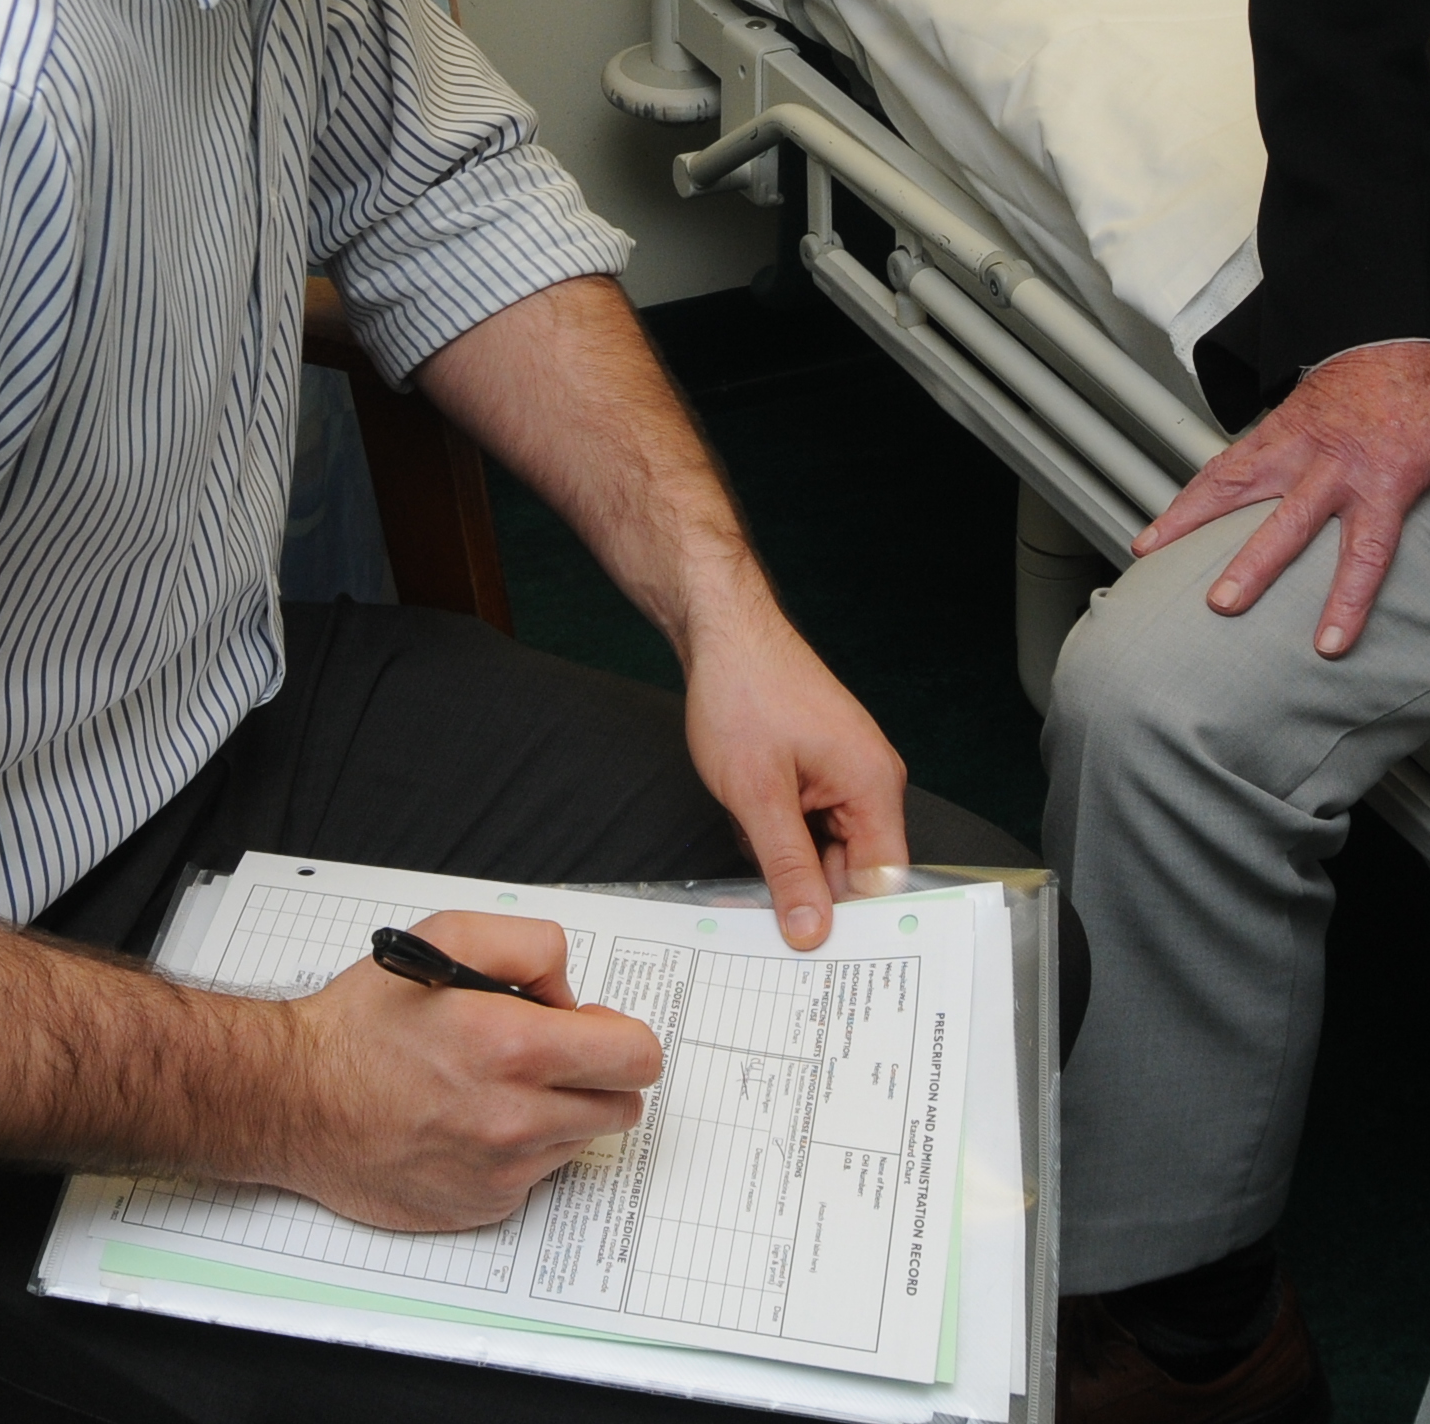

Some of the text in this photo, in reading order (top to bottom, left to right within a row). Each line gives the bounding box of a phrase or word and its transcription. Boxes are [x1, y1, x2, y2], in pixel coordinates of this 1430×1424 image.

[801, 970, 810, 985] Date
[840, 964, 850, 980] Date
[883, 962, 892, 989] Weight:
[670, 980, 685, 1010] CODES
[808, 998, 820, 1022] IN USE
[813, 963, 834, 1058] OTHER MEDICINE CHARTS
[842, 963, 861, 1060] DISCHARGE PRESCRIPTION
[666, 1011, 678, 1029] FOR
[794, 1008, 805, 1022] Type
[863, 1006, 871, 1023] date:
[792, 1028, 802, 1045] Chart
[824, 1056, 838, 1090] Completed
[871, 1062, 882, 1086] Height:
[794, 1064, 819, 1179] PREVIOUS ADVERSE REACTIONS
[641, 1132, 652, 1146] OF
[902, 1119, 920, 1185] Standard Chart
[904, 1012, 946, 1297] PRESCRIPTION AND ADMINISTRATION RECORD
[750, 1147, 764, 1181] Description
[843, 1151, 853, 1171] D.O.B.
[857, 1154, 870, 1197] CHI Number:
[628, 1148, 649, 1209] PRESCRIBED
[873, 1156, 888, 1210] Name of Patient:
[595, 1165, 625, 1267] the appropriate timescale.
[745, 1188, 756, 1213] reaction
[537, 1213, 560, 1285] reaction side effect
[616, 1211, 637, 1264] MEDICINE
[808, 1201, 827, 1273] (Attach printed label here)
[776, 1243, 791, 1288] Completed by
[772, 1305, 782, 1322] Date
